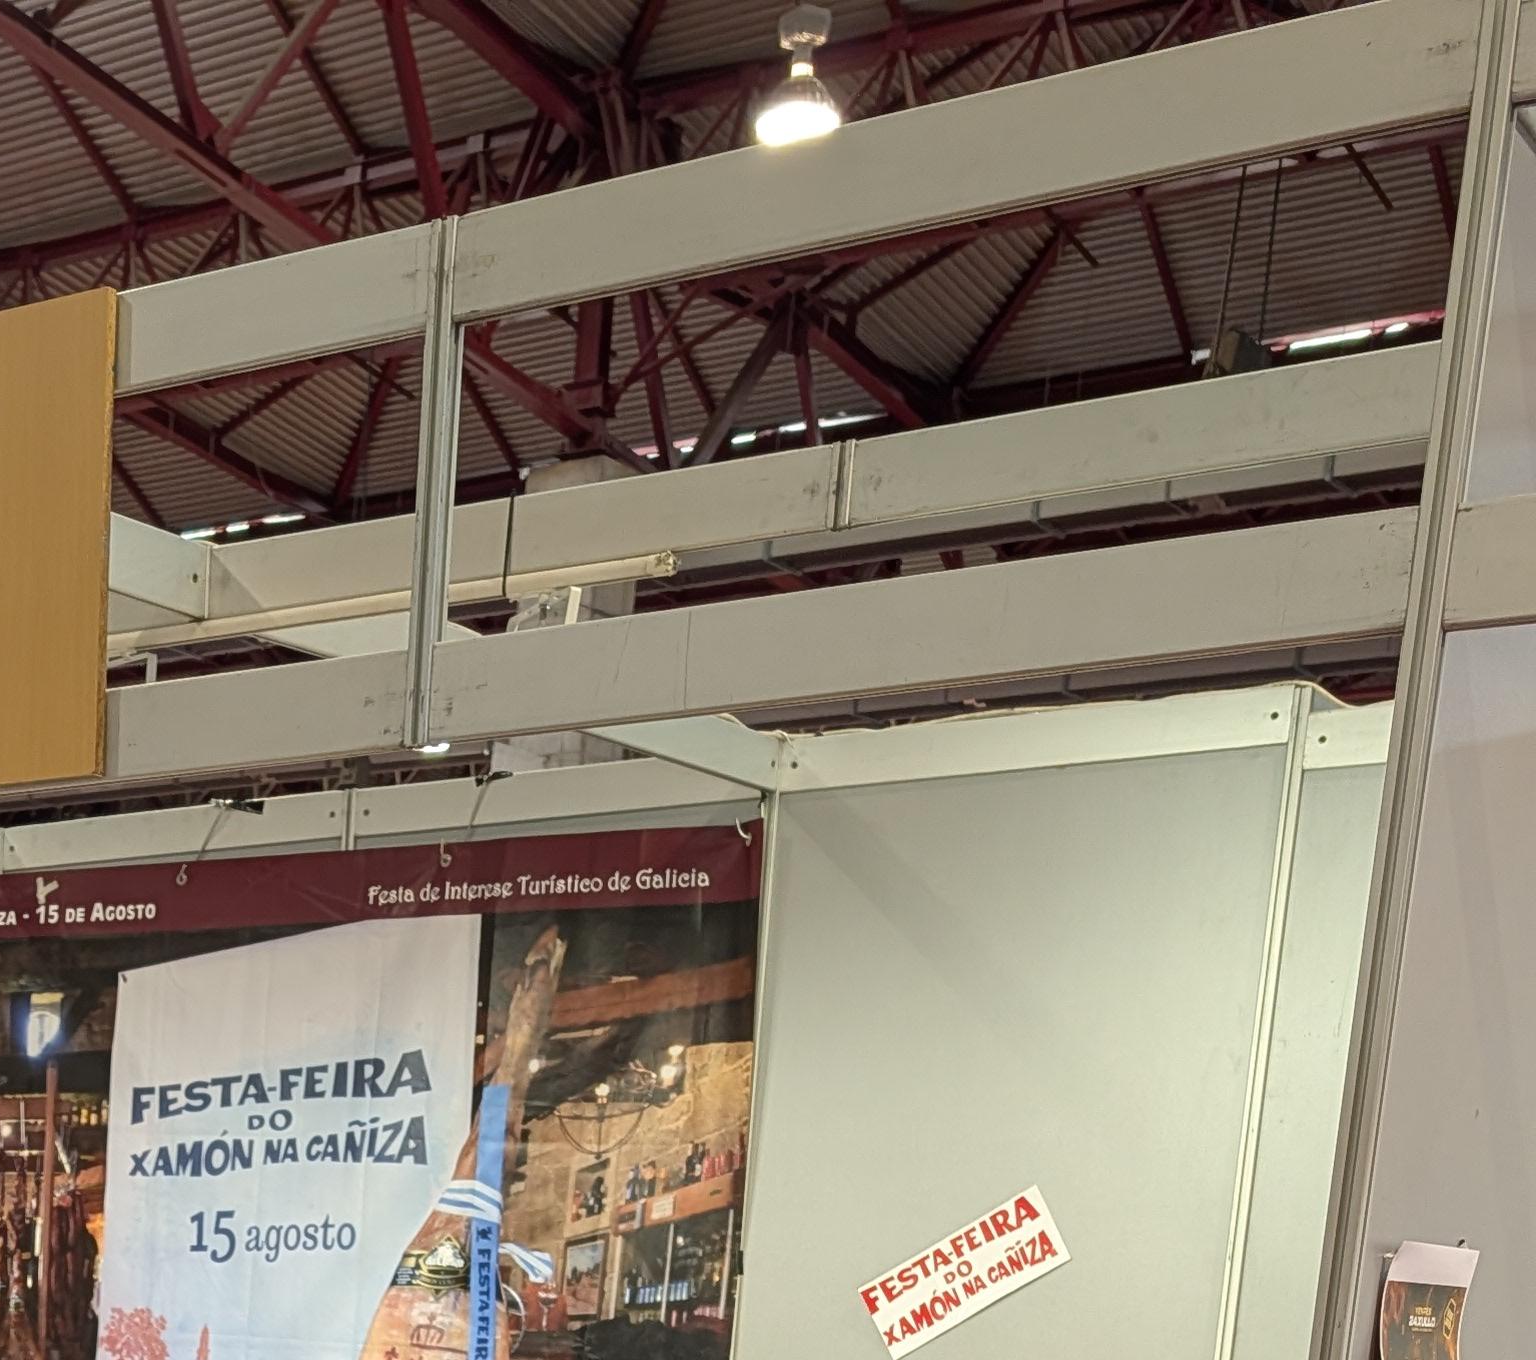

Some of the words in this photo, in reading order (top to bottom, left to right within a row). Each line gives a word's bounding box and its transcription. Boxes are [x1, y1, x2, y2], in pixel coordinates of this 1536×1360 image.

[368, 885, 415, 905] Festa
[419, 882, 441, 903] de
[444, 880, 514, 901] Interese
[517, 874, 603, 896] Turístico
[607, 870, 632, 893] de
[635, 868, 710, 890] Galicia
[35, 905, 60, 924] 15
[131, 1049, 432, 1125] FESTA-FEIRA
[247, 1109, 293, 1131] DO
[128, 1130, 254, 1177] XAMÓN
[263, 1138, 299, 1166] NA
[189, 1209, 237, 1263] 15
[245, 1213, 357, 1263] agosto
[860, 1196, 1041, 1316] FESTA-FEIRA
[943, 1260, 973, 1284] DO
[883, 1288, 962, 1347] XAMÓN
[962, 1274, 987, 1299] NA
